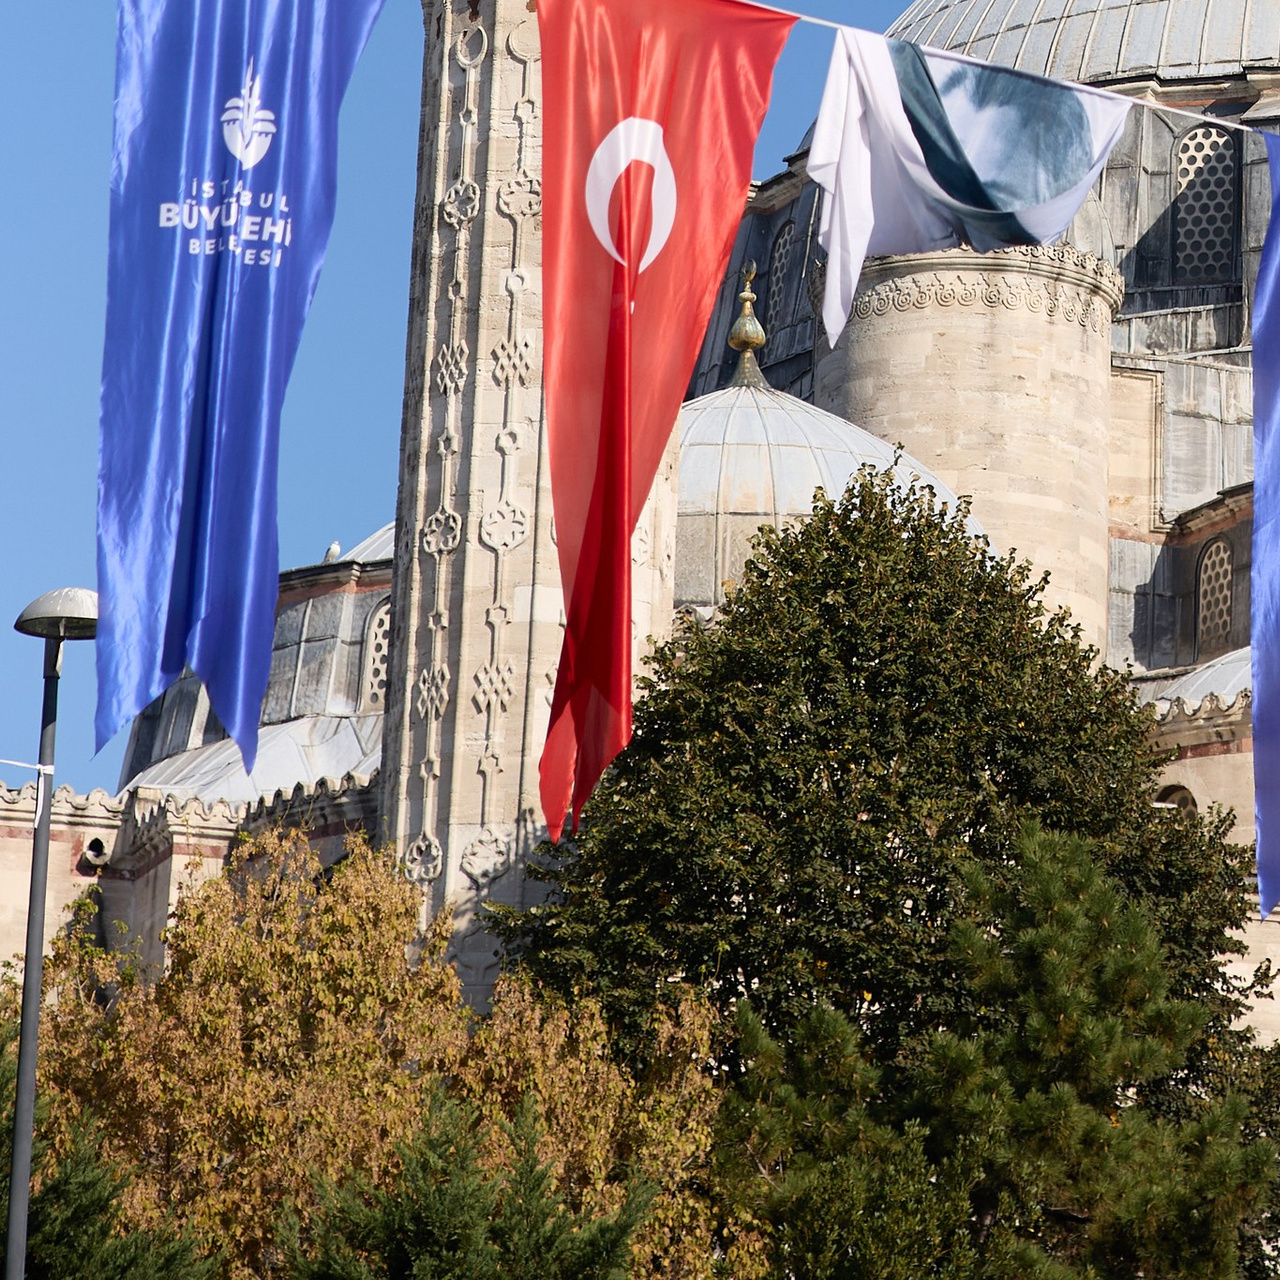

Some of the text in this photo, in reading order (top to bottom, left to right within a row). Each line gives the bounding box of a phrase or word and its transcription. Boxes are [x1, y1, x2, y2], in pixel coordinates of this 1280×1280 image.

[192, 177, 289, 212] İSTABUL
[159, 197, 292, 246] BÜYÜEHİ
[189, 234, 283, 268] BELEESİ
